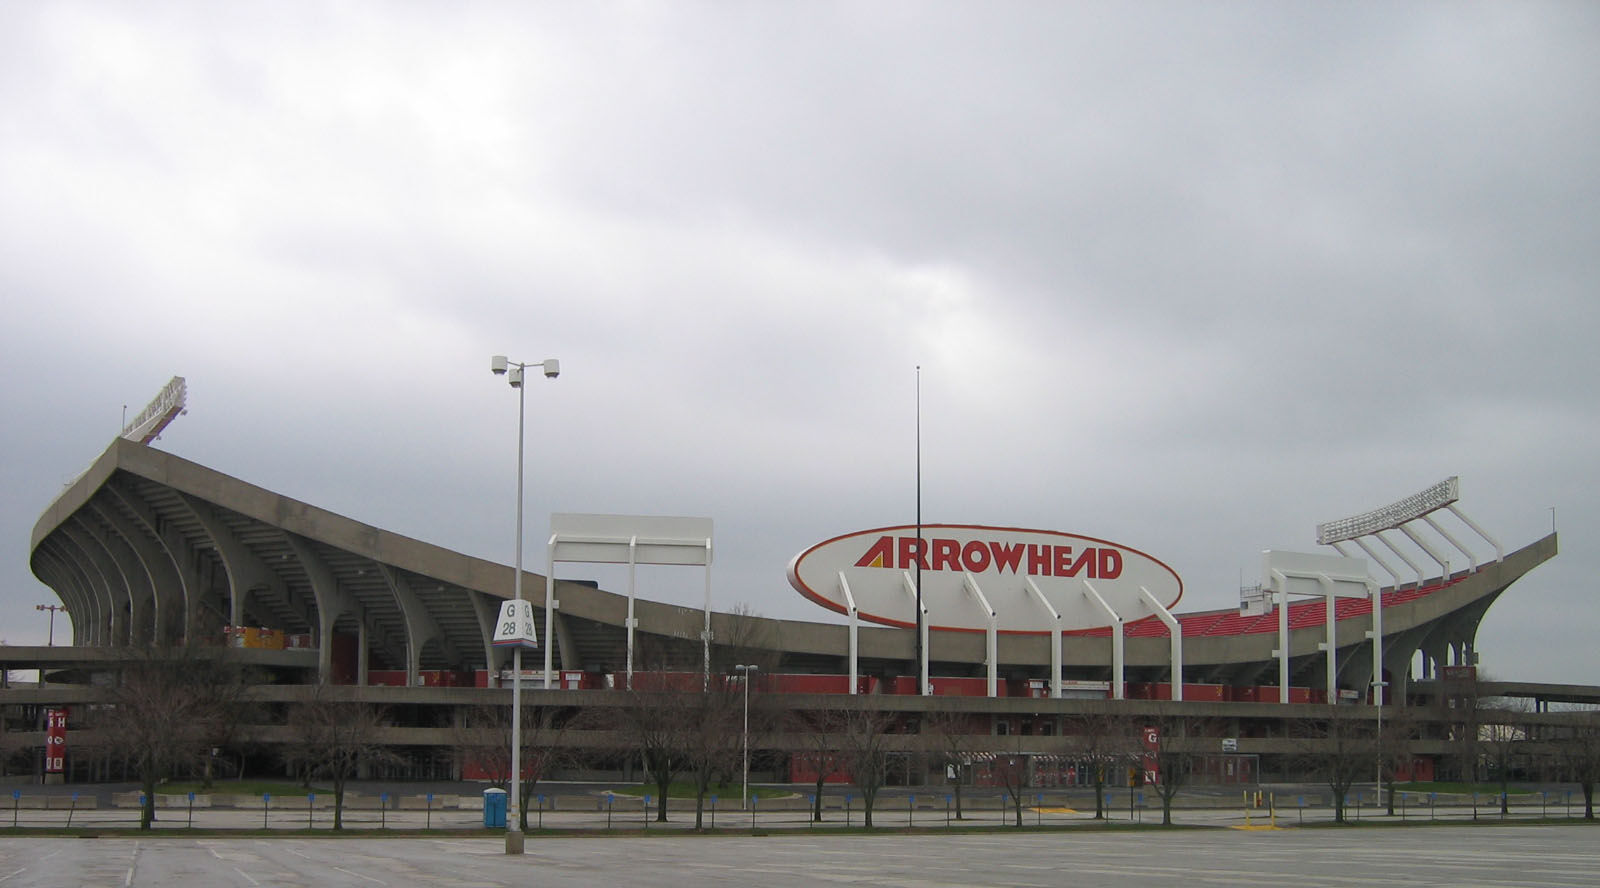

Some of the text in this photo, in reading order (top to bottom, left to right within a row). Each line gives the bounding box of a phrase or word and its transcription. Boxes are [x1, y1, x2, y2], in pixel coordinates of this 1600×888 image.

[853, 536, 1123, 580] ARROWHEAD
[506, 604, 515, 617] G
[502, 622, 516, 635] 28
[58, 717, 65, 727] H
[1148, 733, 1157, 743] G
